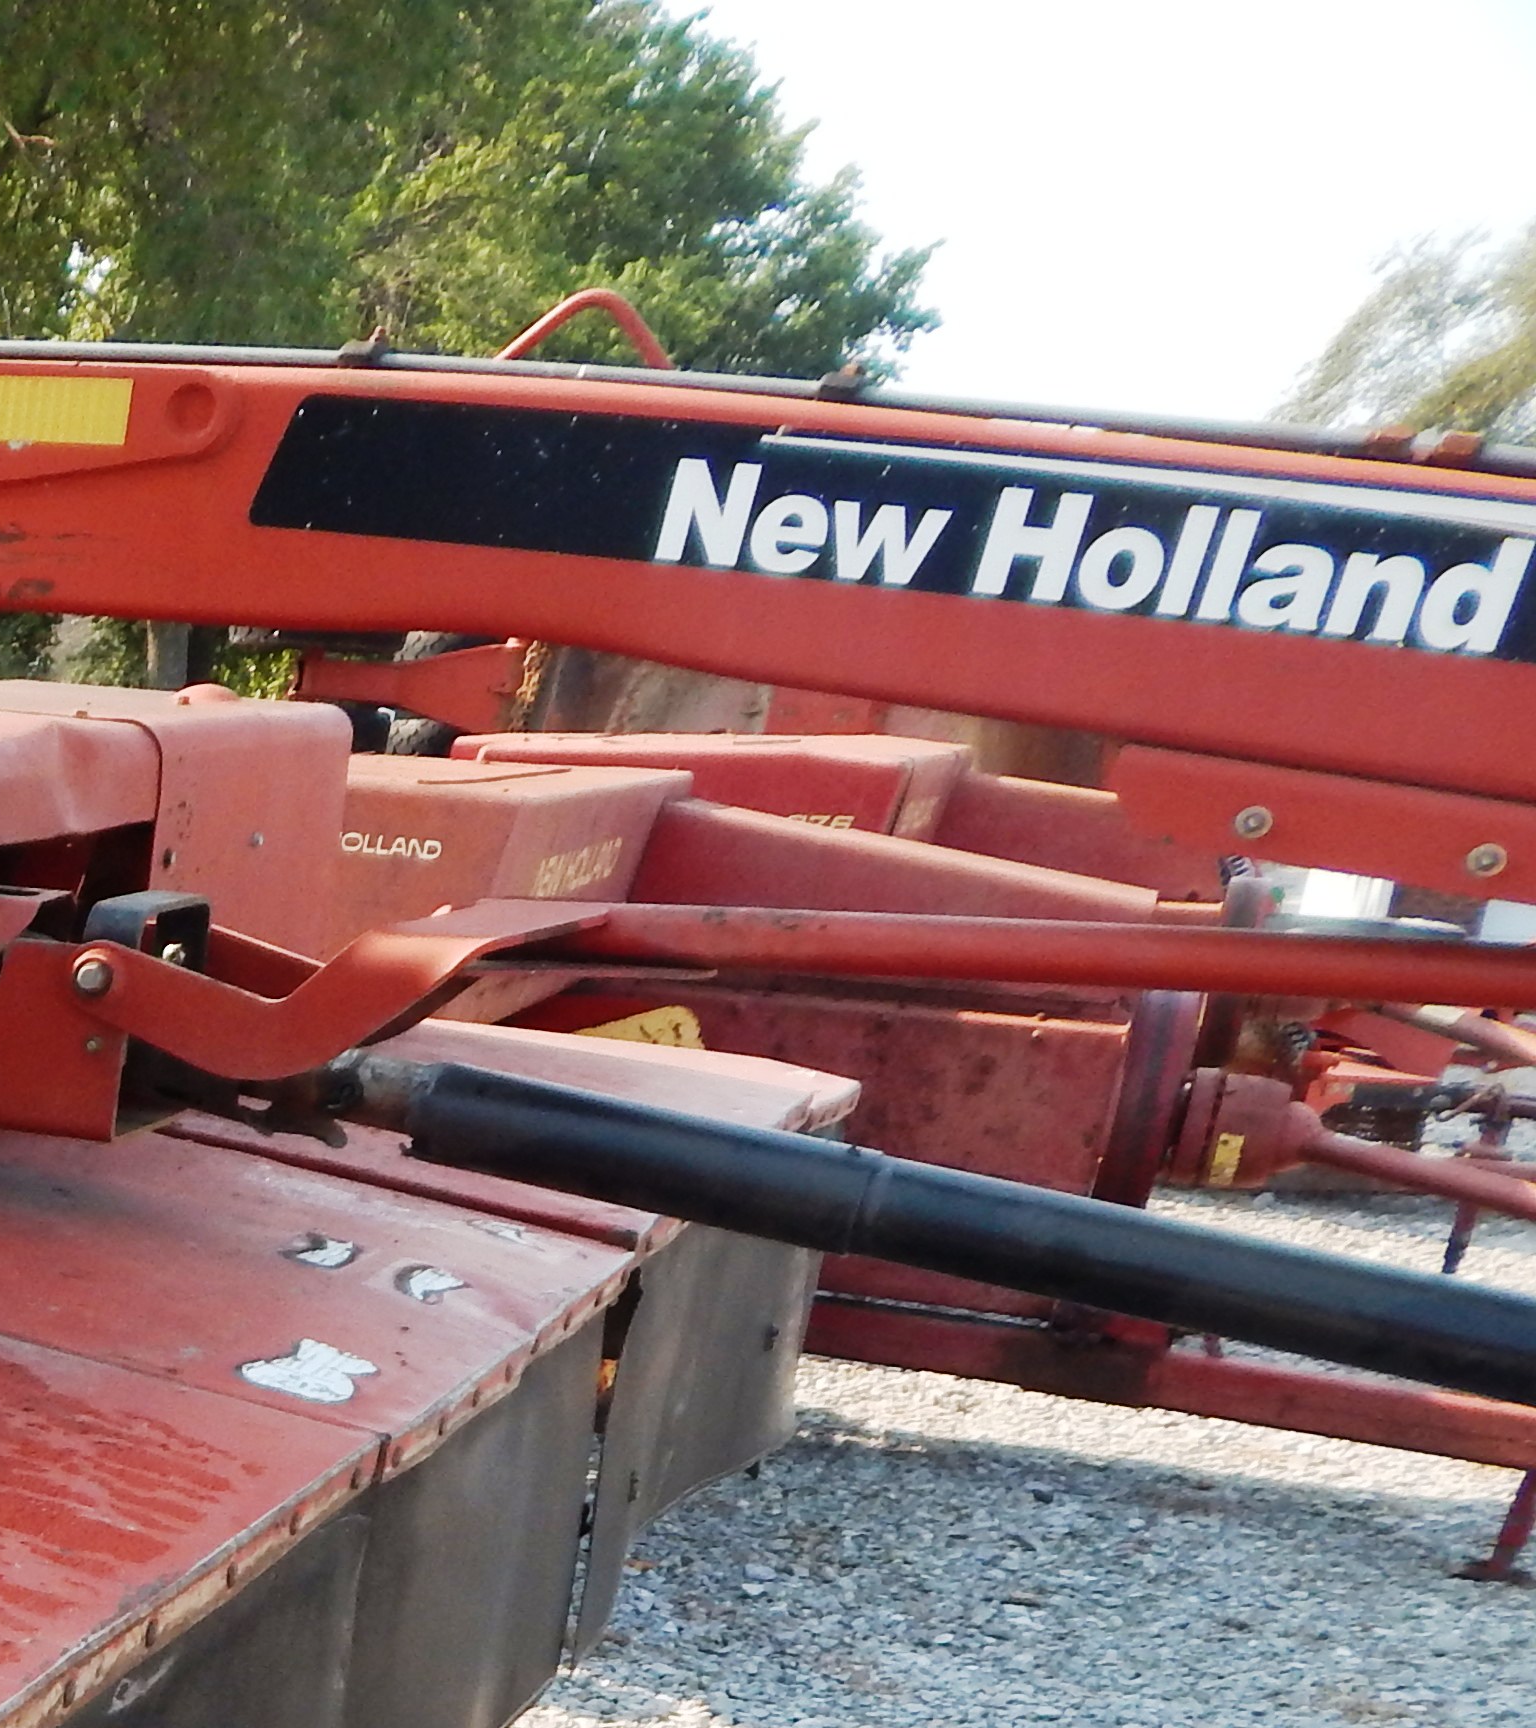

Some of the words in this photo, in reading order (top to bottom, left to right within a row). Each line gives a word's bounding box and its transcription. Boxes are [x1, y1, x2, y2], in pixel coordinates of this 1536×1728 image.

[653, 457, 952, 587] New
[971, 485, 1535, 655] Holland
[339, 831, 442, 860] OLLAND
